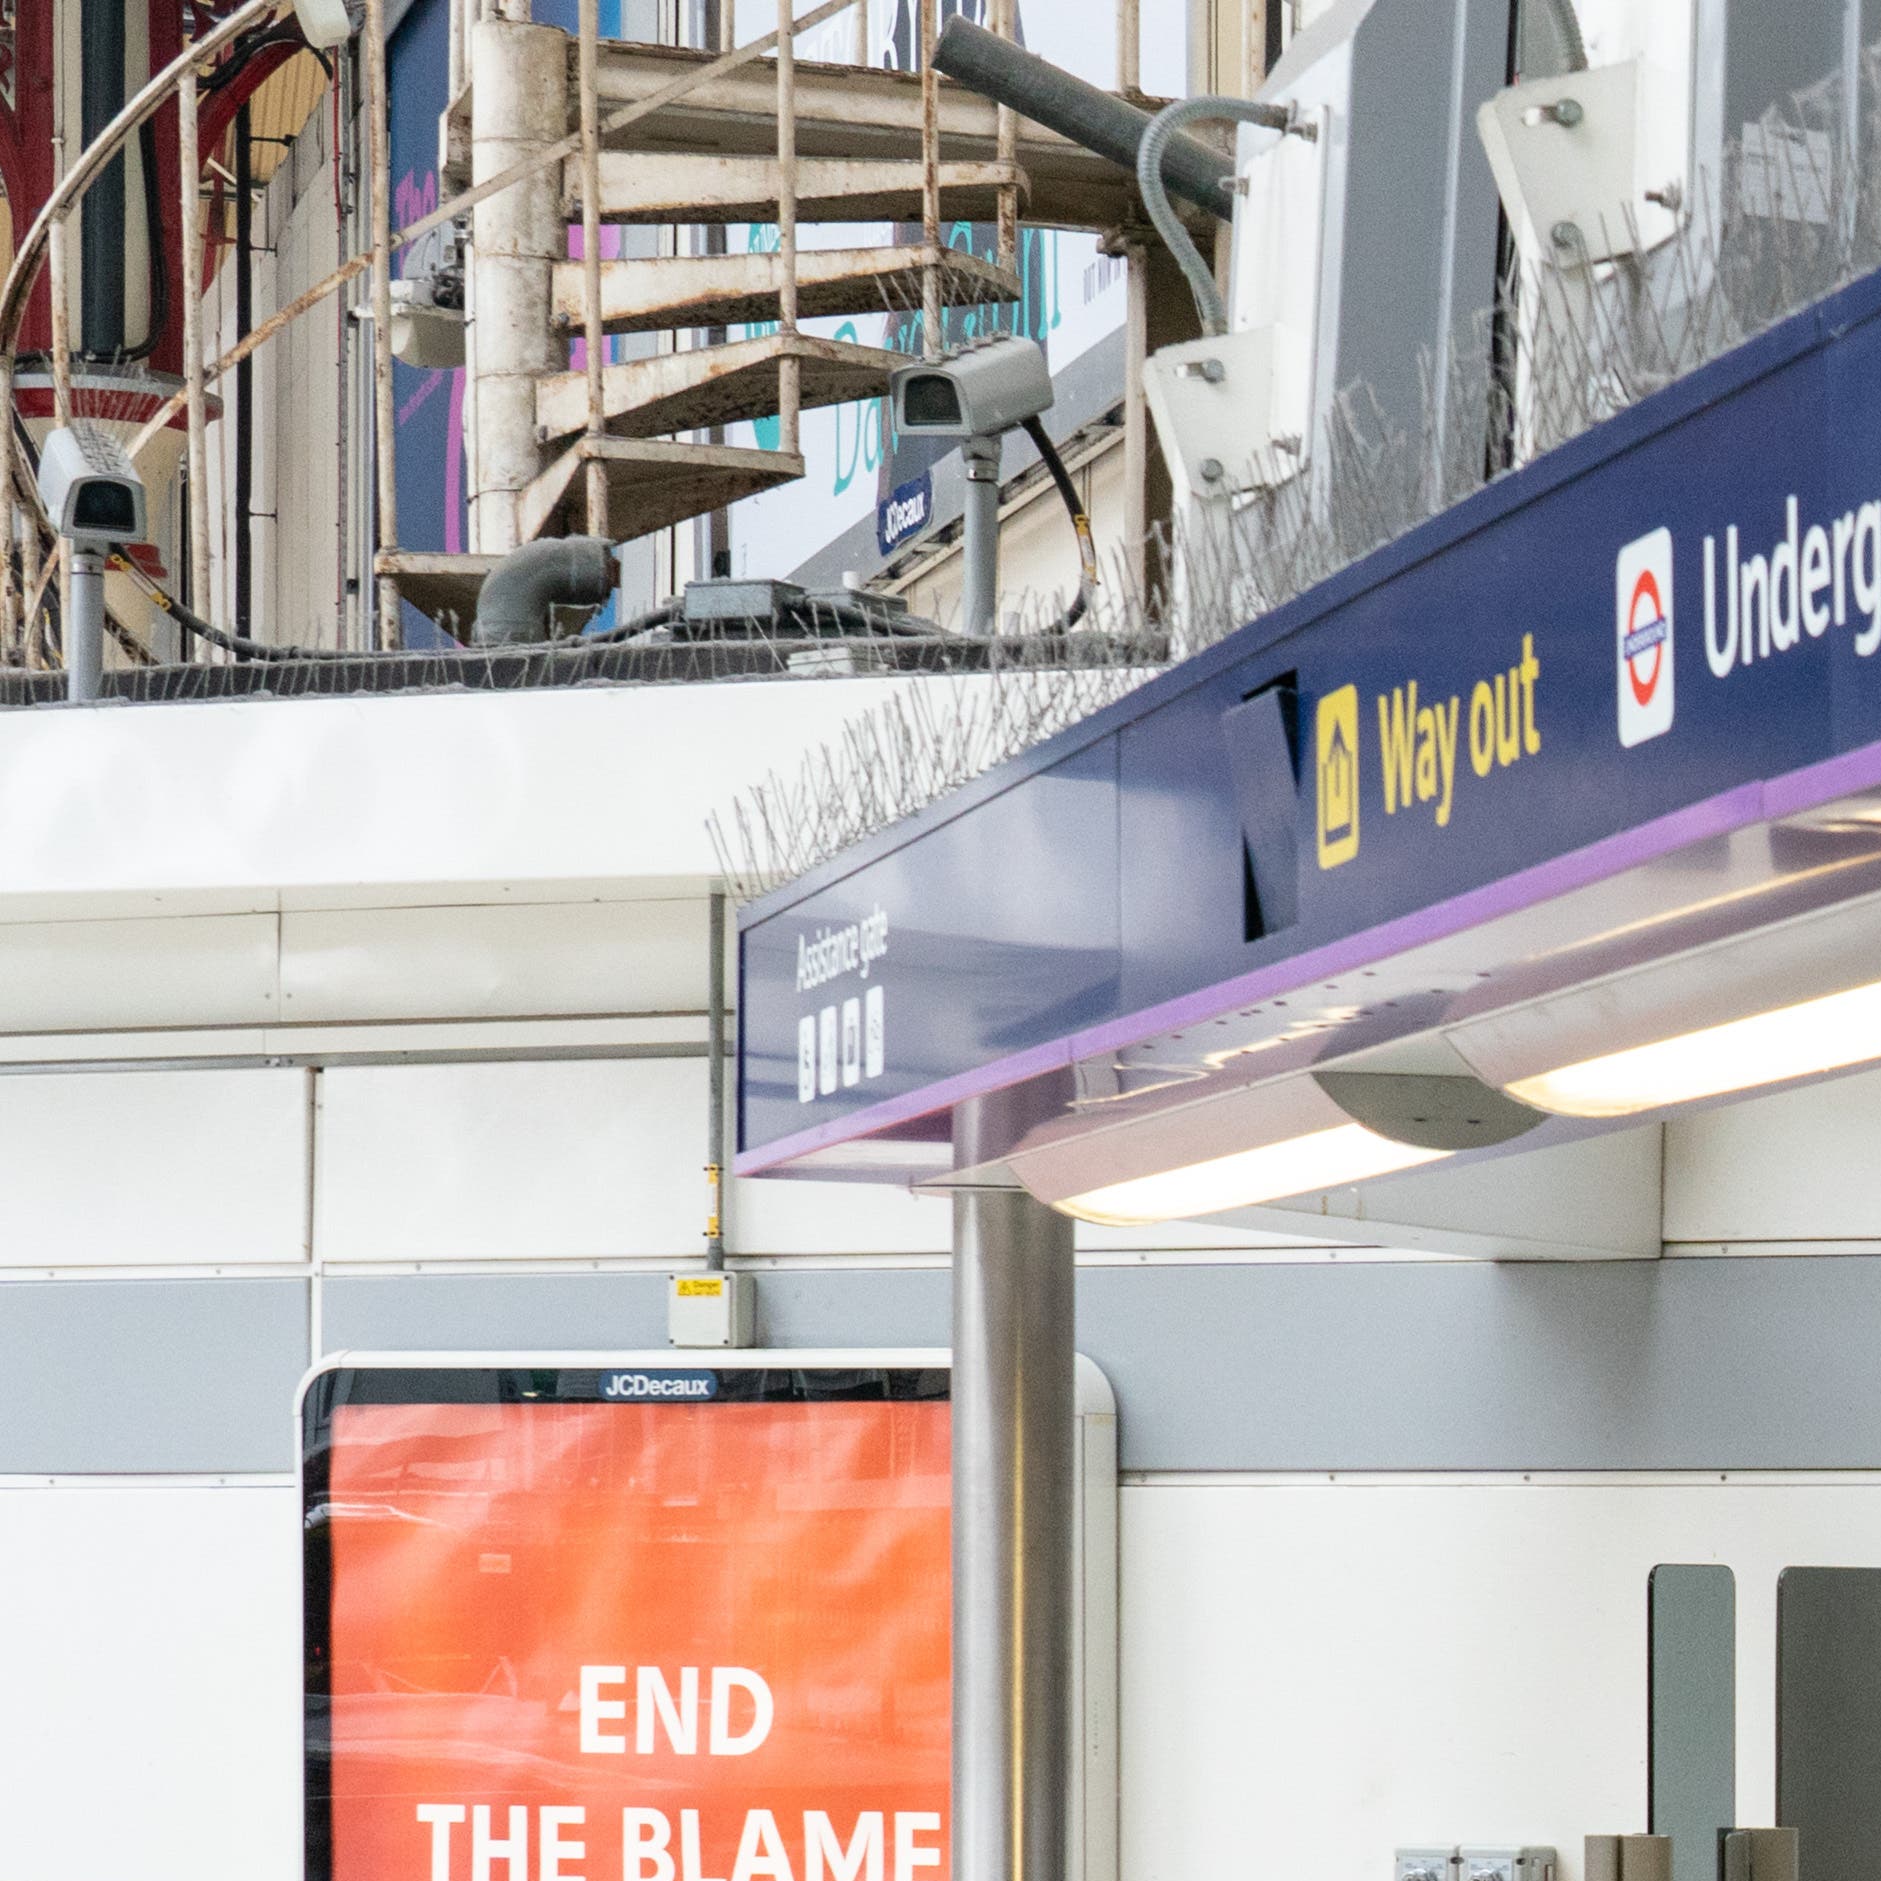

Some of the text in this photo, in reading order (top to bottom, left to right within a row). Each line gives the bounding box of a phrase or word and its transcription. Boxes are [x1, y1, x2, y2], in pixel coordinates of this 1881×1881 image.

[1378, 632, 1541, 826] Way out
[797, 903, 888, 992] Assistance gate
[605, 1375, 710, 1396] JCDecaux
[579, 1665, 773, 1756] END
